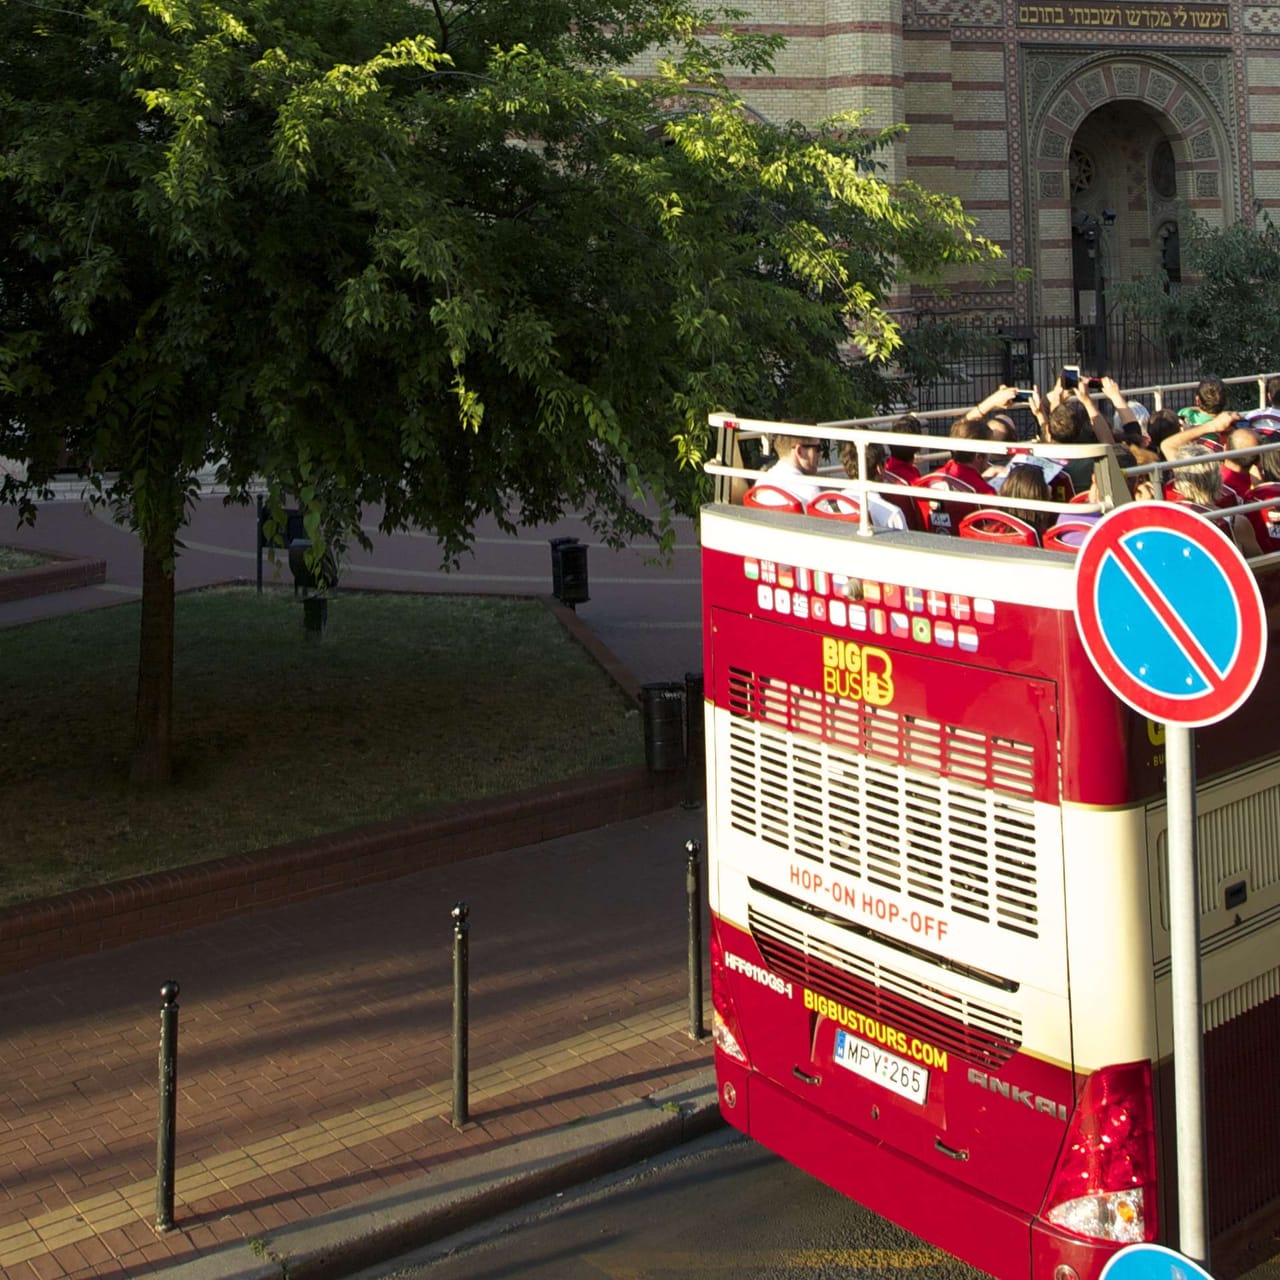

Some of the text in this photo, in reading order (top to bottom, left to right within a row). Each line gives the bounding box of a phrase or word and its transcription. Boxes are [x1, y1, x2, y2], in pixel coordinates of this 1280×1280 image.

[823, 636, 861, 672] BIG
[824, 666, 862, 700] BUS
[790, 864, 949, 941] HOP-ON HOP-OFF
[804, 988, 948, 1072] BIGBUSTOURS.COM
[967, 1068, 1067, 1123] ANKAI
